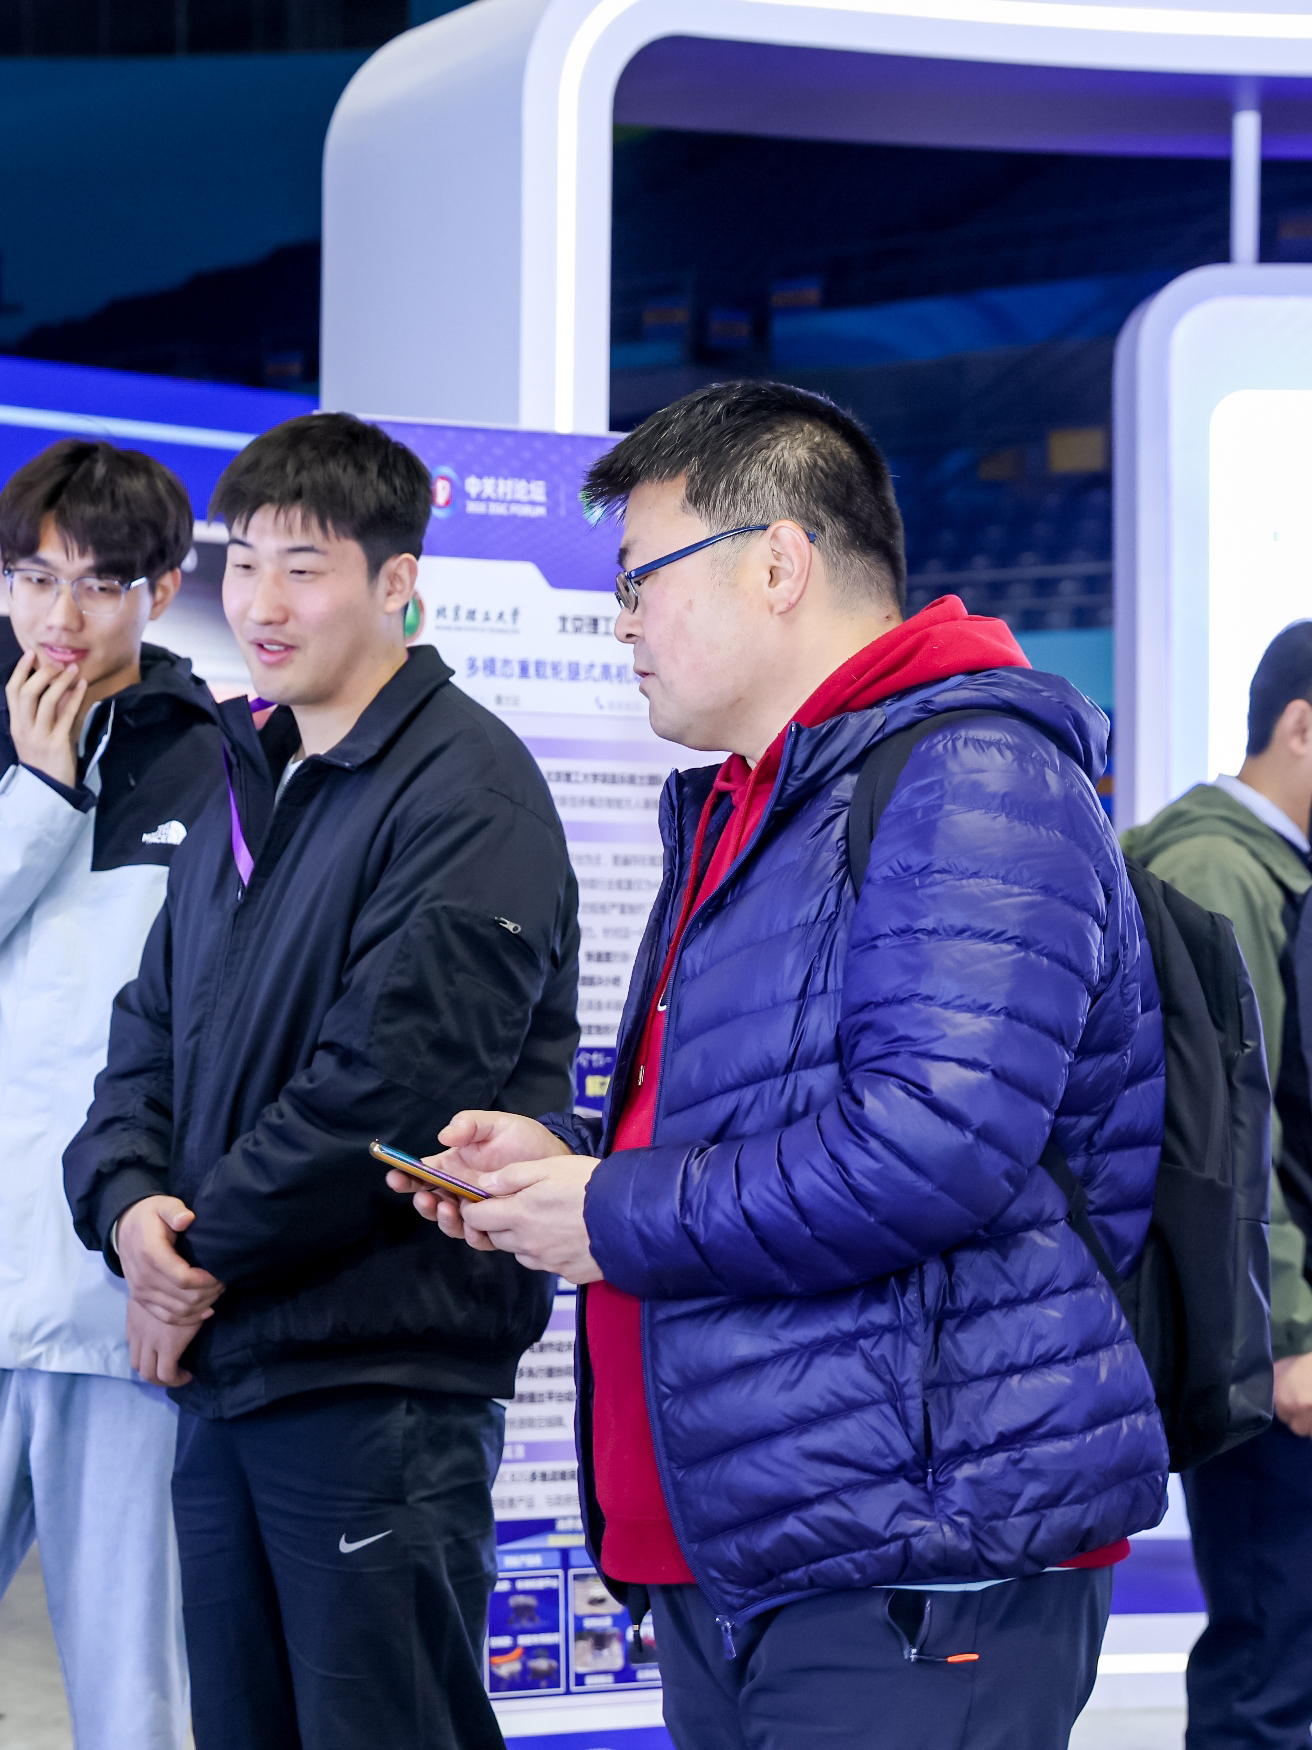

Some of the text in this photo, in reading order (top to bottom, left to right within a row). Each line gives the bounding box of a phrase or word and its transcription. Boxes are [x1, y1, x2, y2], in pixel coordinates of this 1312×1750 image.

[464, 475, 547, 502] 中关村论坛
